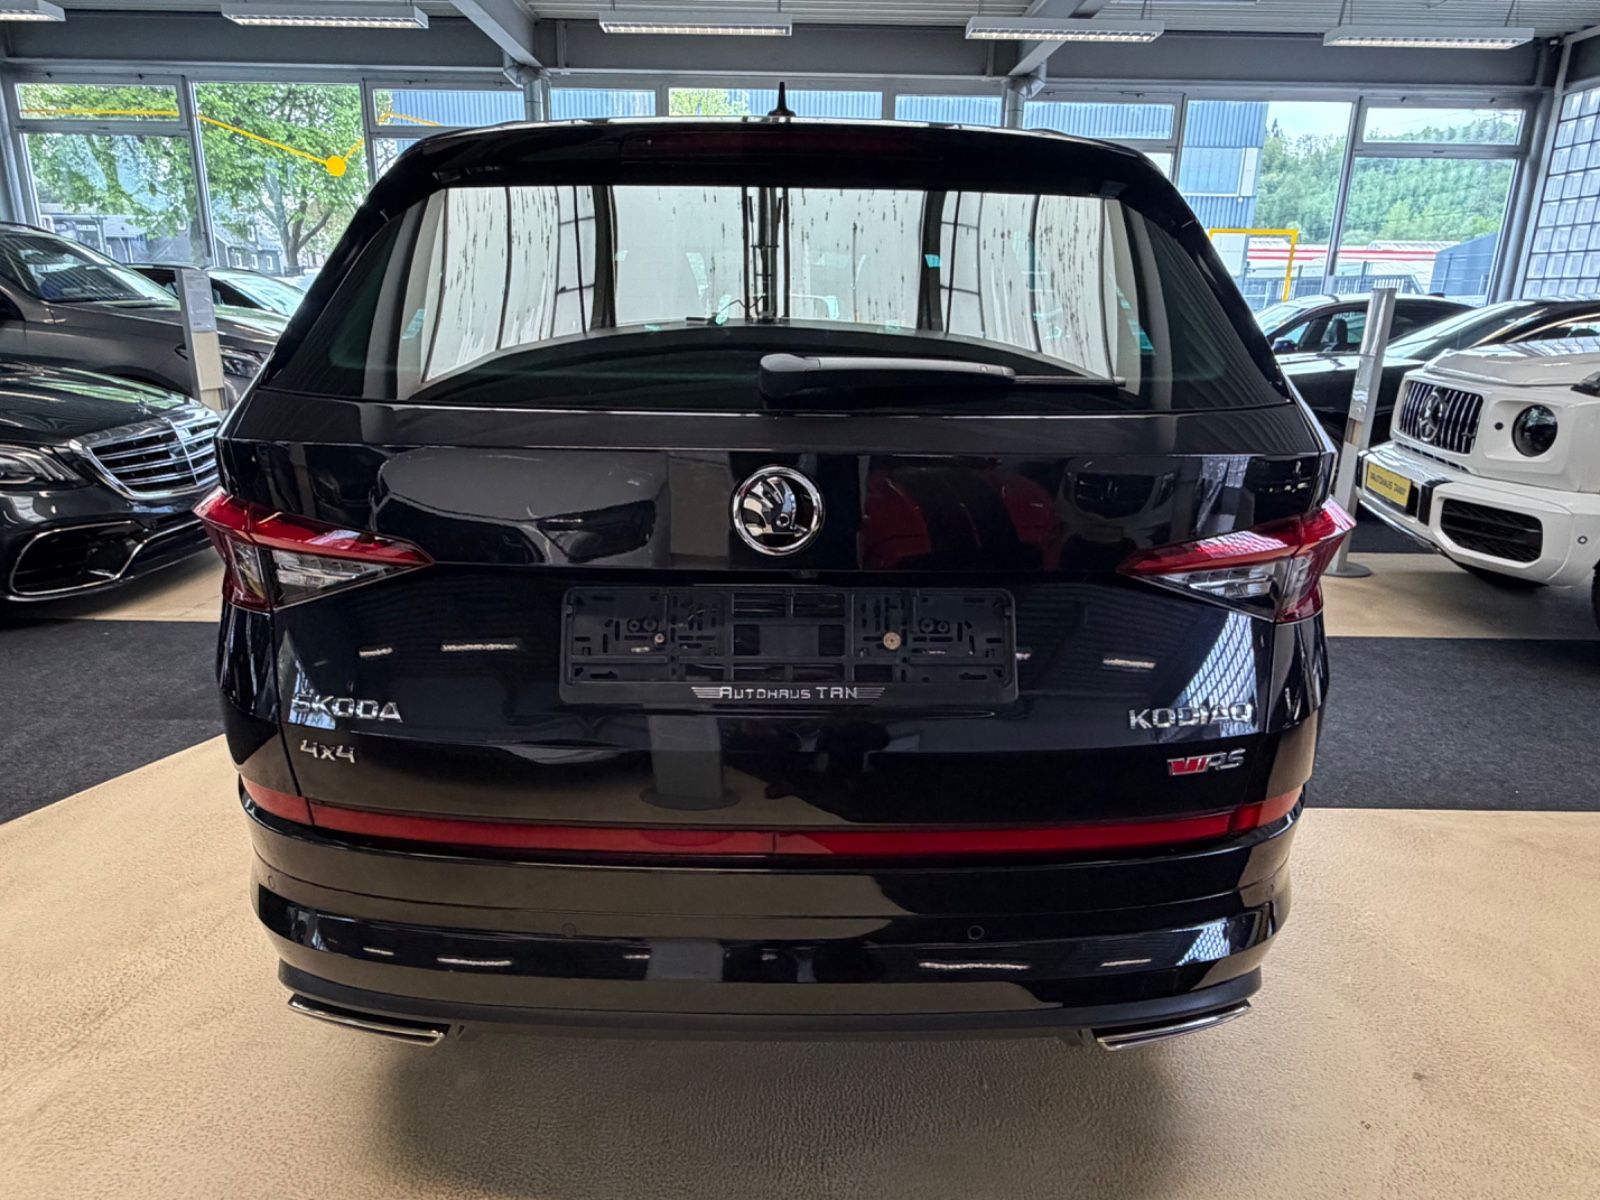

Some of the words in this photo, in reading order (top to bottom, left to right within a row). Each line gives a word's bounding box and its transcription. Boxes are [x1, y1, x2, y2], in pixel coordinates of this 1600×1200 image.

[719, 686, 811, 699] AUTOHAUS
[815, 686, 858, 699] TAN
[1128, 702, 1254, 730] KODIAQ
